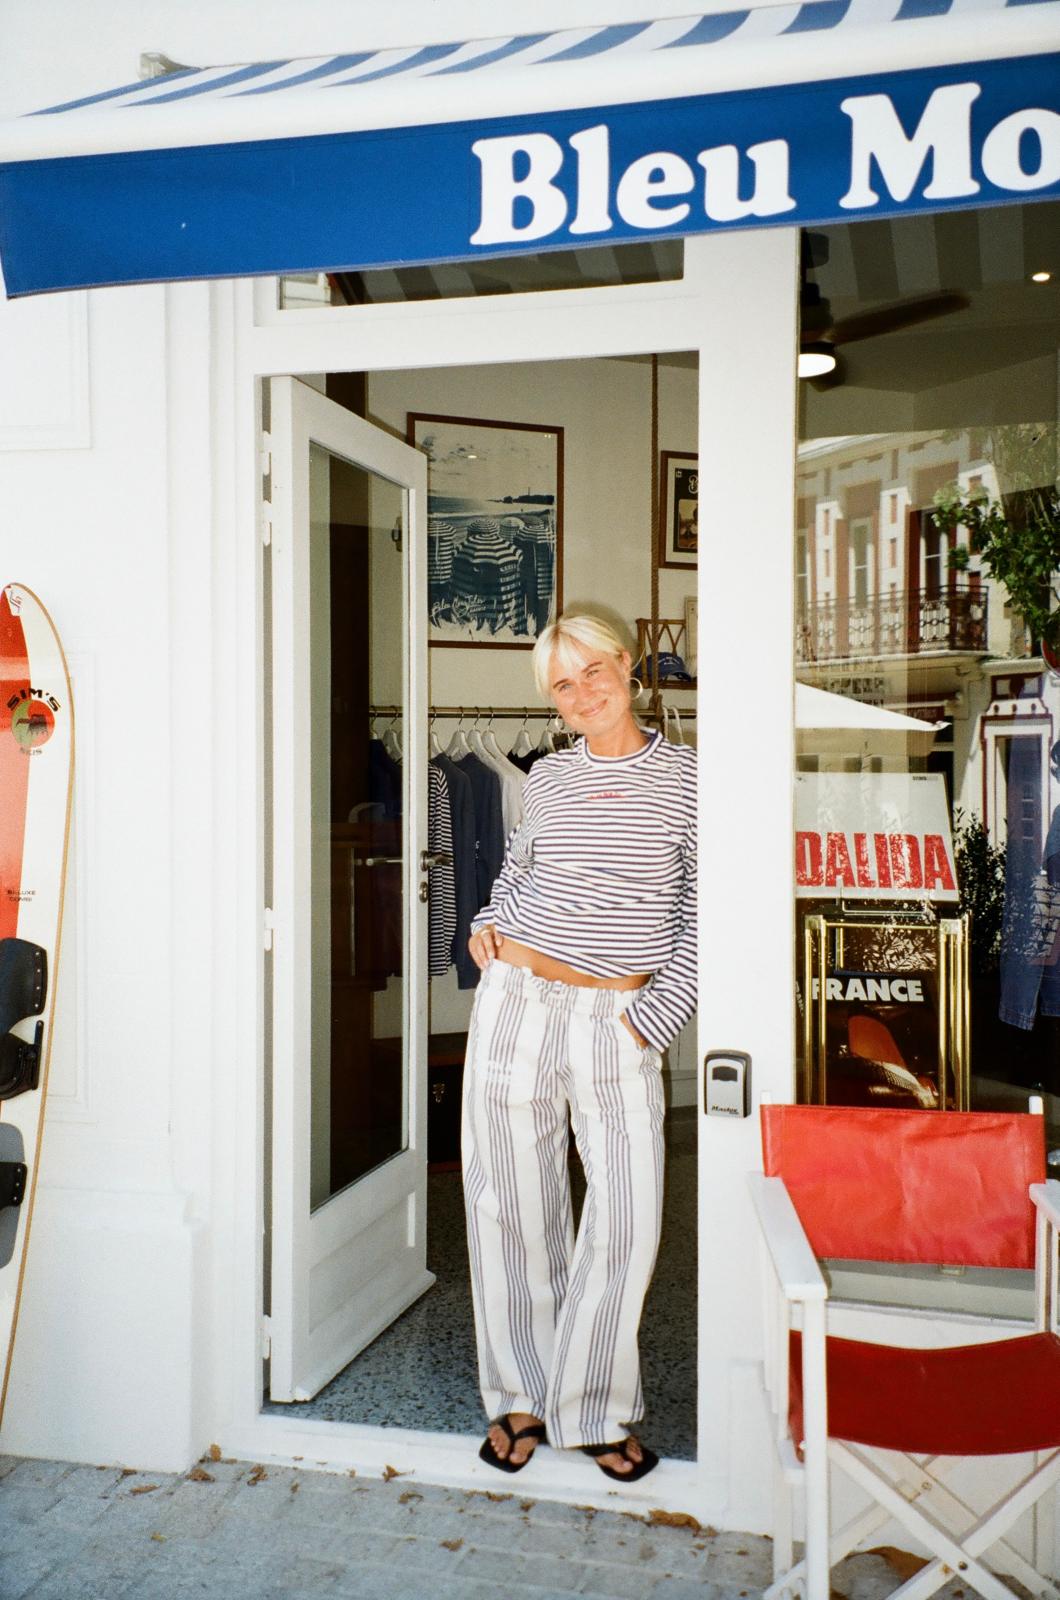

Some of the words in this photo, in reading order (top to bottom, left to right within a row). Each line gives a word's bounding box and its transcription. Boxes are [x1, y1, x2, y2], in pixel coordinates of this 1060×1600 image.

[469, 124, 797, 246] Bleu
[839, 82, 1060, 209] Mo
[795, 831, 955, 890] DALIDA
[812, 978, 924, 1002] FRANCE
